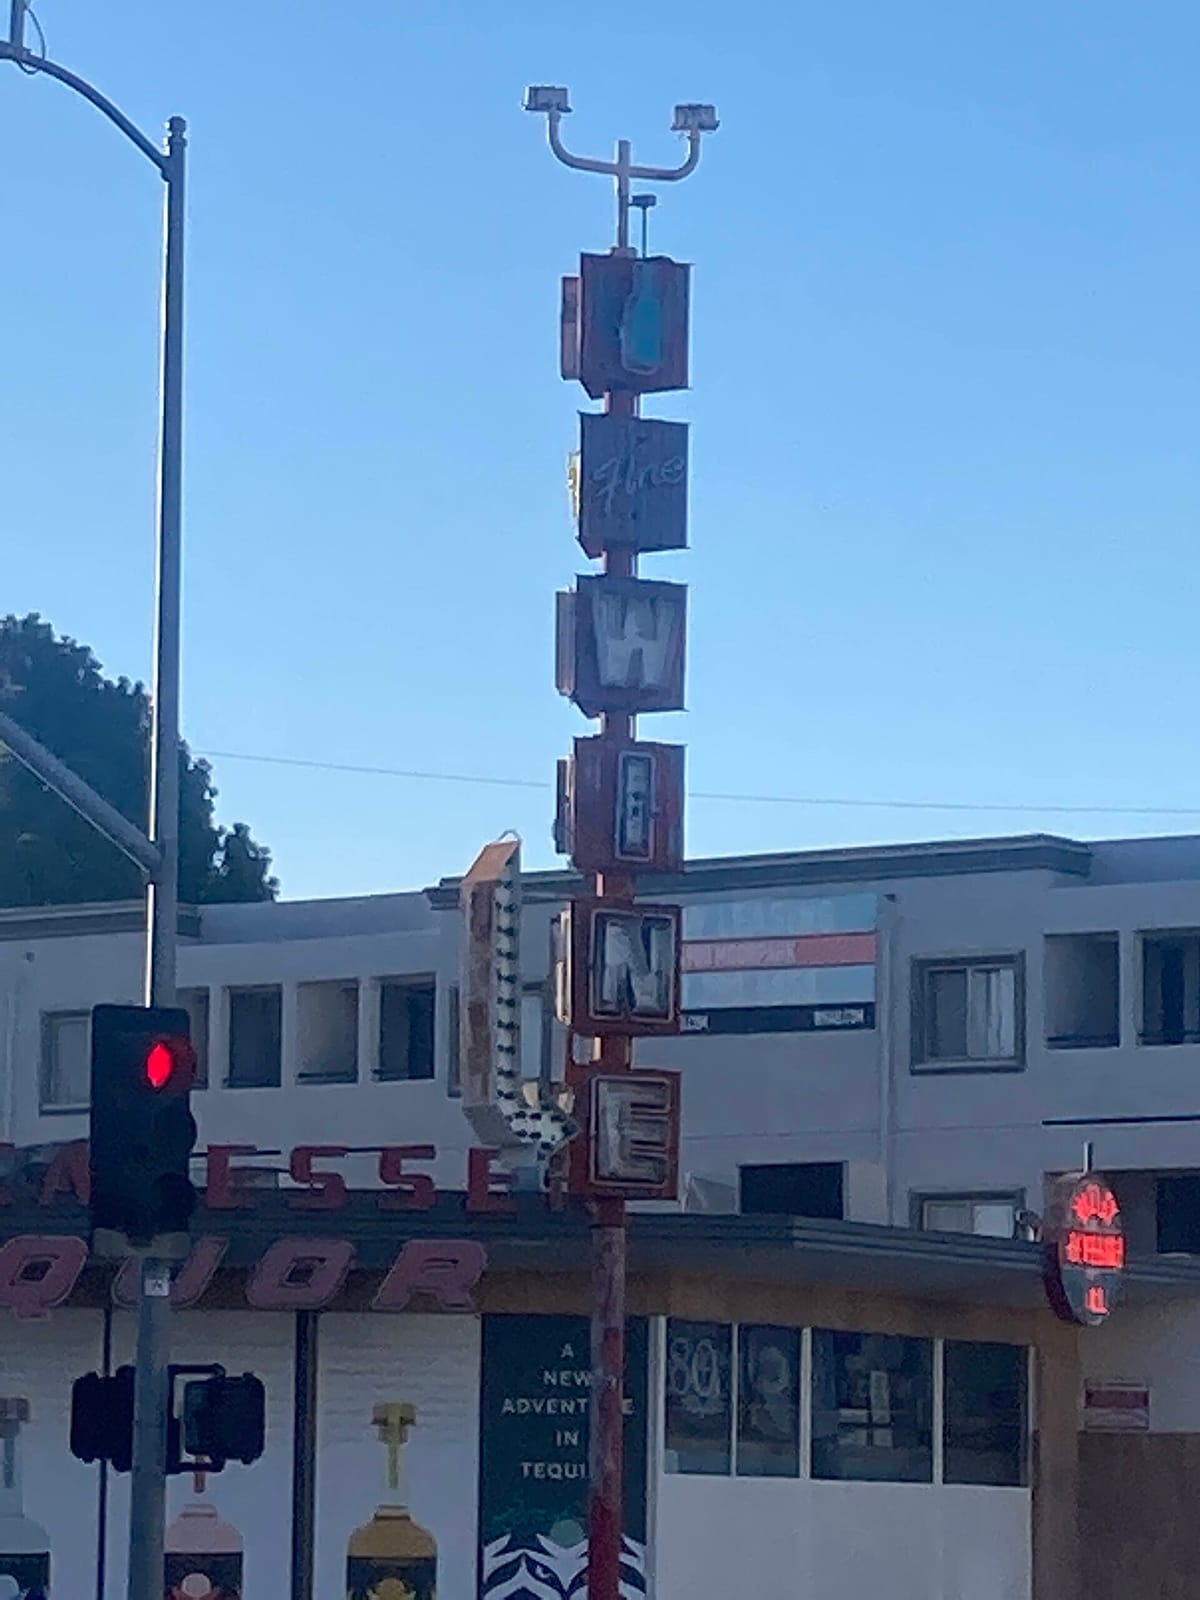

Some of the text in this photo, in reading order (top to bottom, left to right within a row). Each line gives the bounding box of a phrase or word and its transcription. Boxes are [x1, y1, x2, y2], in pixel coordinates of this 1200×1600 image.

[592, 590, 678, 1180] WINE
[0, 1141, 517, 1213] AESSE
[560, 1342, 575, 1358] A
[543, 1369, 592, 1387] NEW
[500, 1397, 636, 1416] ADVENTE
[555, 1430, 580, 1447] IN
[520, 1462, 589, 1481] TEQUI
